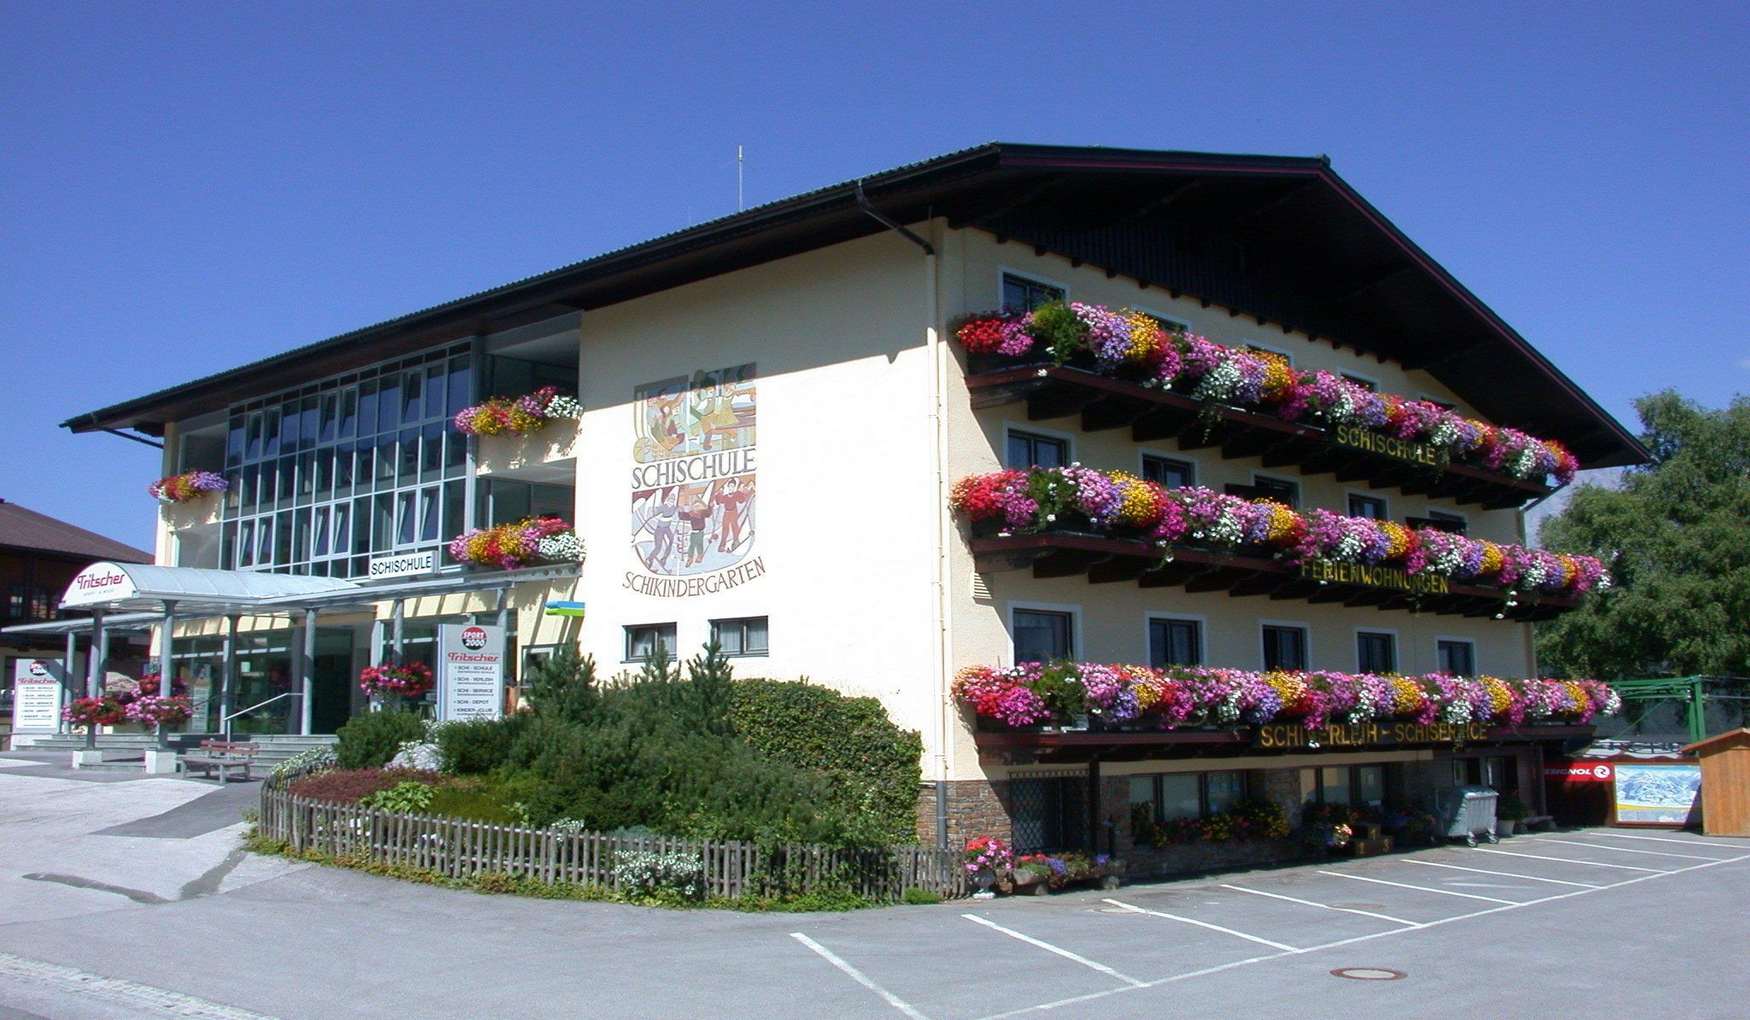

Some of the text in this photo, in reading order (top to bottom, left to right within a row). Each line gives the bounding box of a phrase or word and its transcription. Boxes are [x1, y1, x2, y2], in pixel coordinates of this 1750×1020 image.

[1337, 424, 1436, 465] SCHISCHULE
[632, 448, 757, 490] SCHISCHULE
[371, 556, 432, 575] SCHISCHULE
[622, 556, 767, 598] SCHIKINDERGARTEN
[1302, 559, 1449, 593] FERIENWOHNUNGEN
[77, 570, 125, 590] Tritscher
[463, 631, 486, 640] SPORT
[465, 639, 485, 647] 2000
[448, 652, 498, 662] Tritscher
[1260, 723, 1377, 748] SCHIERLEIH
[1394, 722, 1489, 742] SCHISERICE
